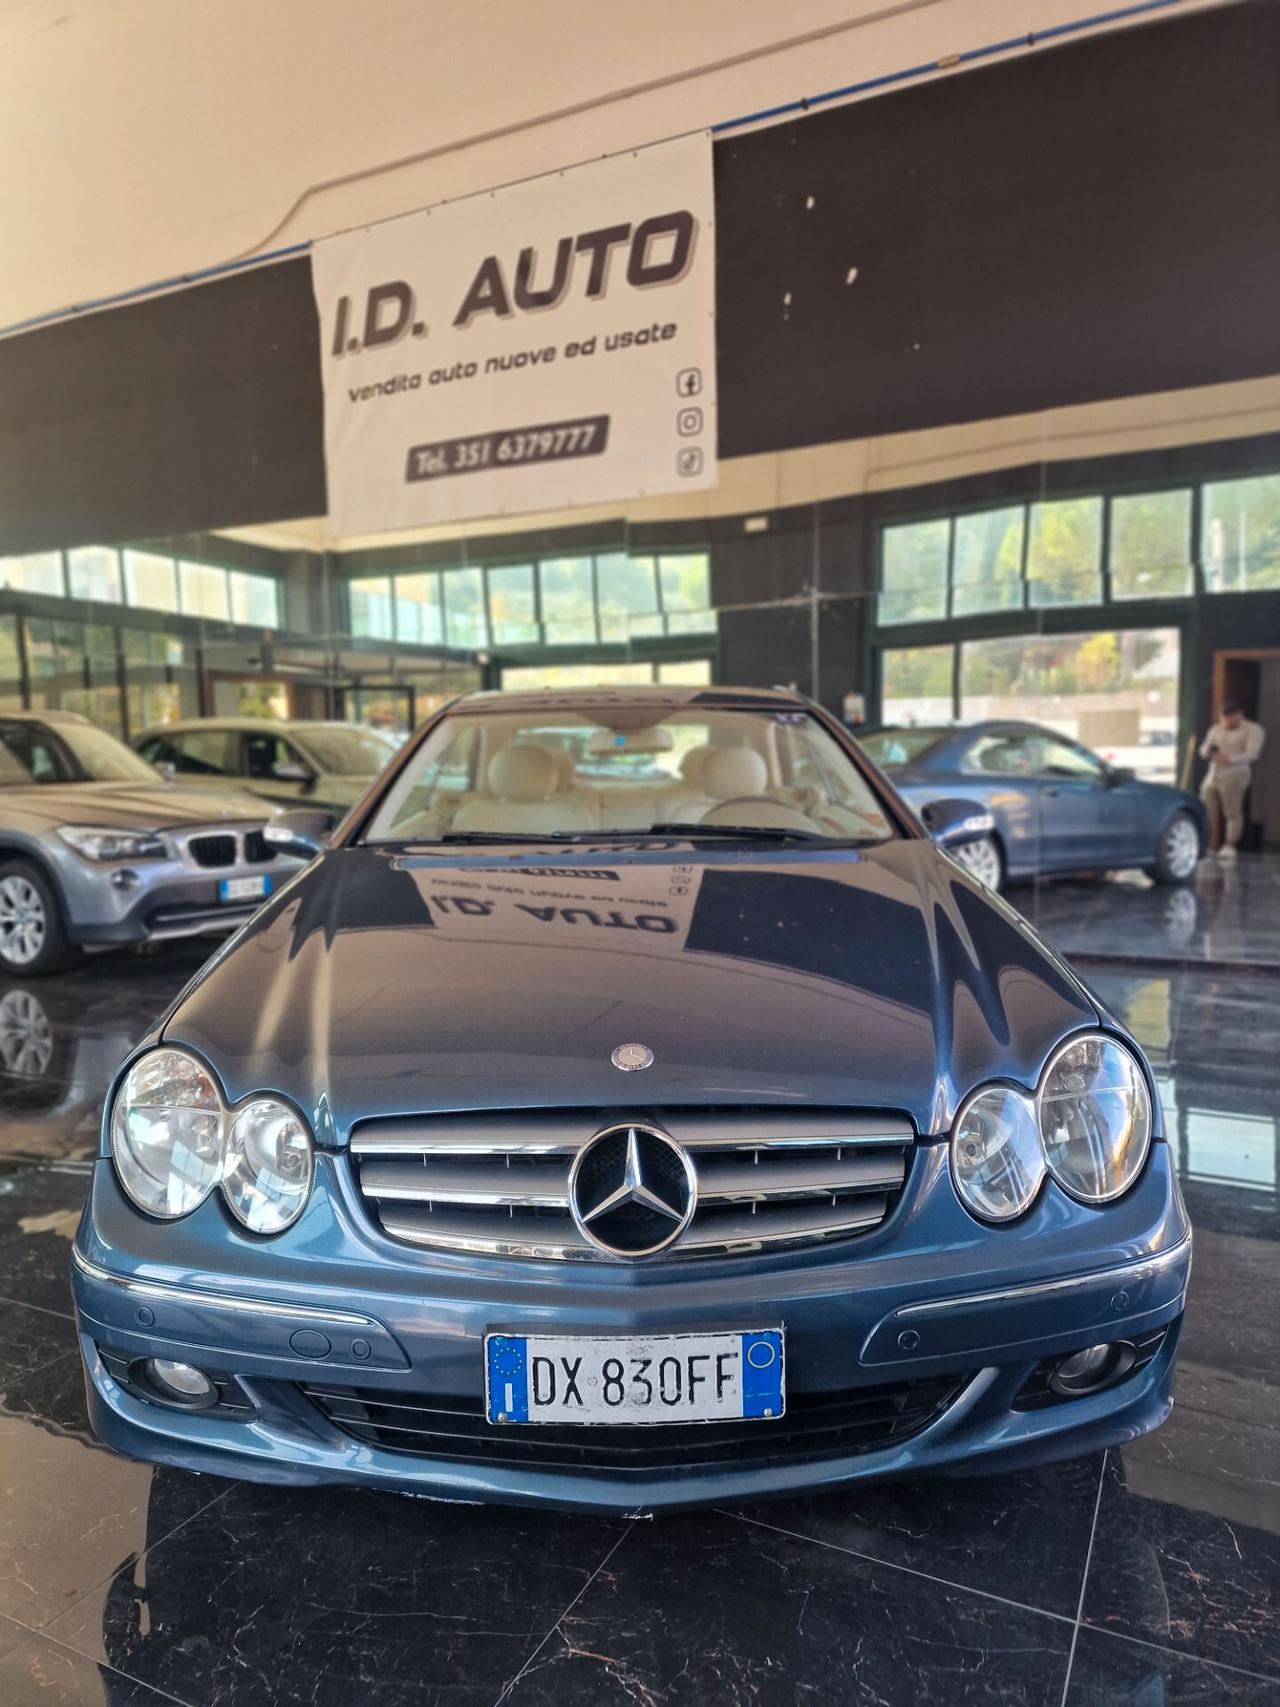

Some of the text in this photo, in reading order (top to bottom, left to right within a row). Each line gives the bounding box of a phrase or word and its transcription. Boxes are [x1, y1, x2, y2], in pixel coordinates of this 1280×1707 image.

[331, 209, 699, 358] I.D. AUTO
[348, 323, 677, 402] vendita auto nuove ed usate
[415, 424, 596, 474] Tel. 351 6379777
[532, 1352, 739, 1406] DX 830FF
